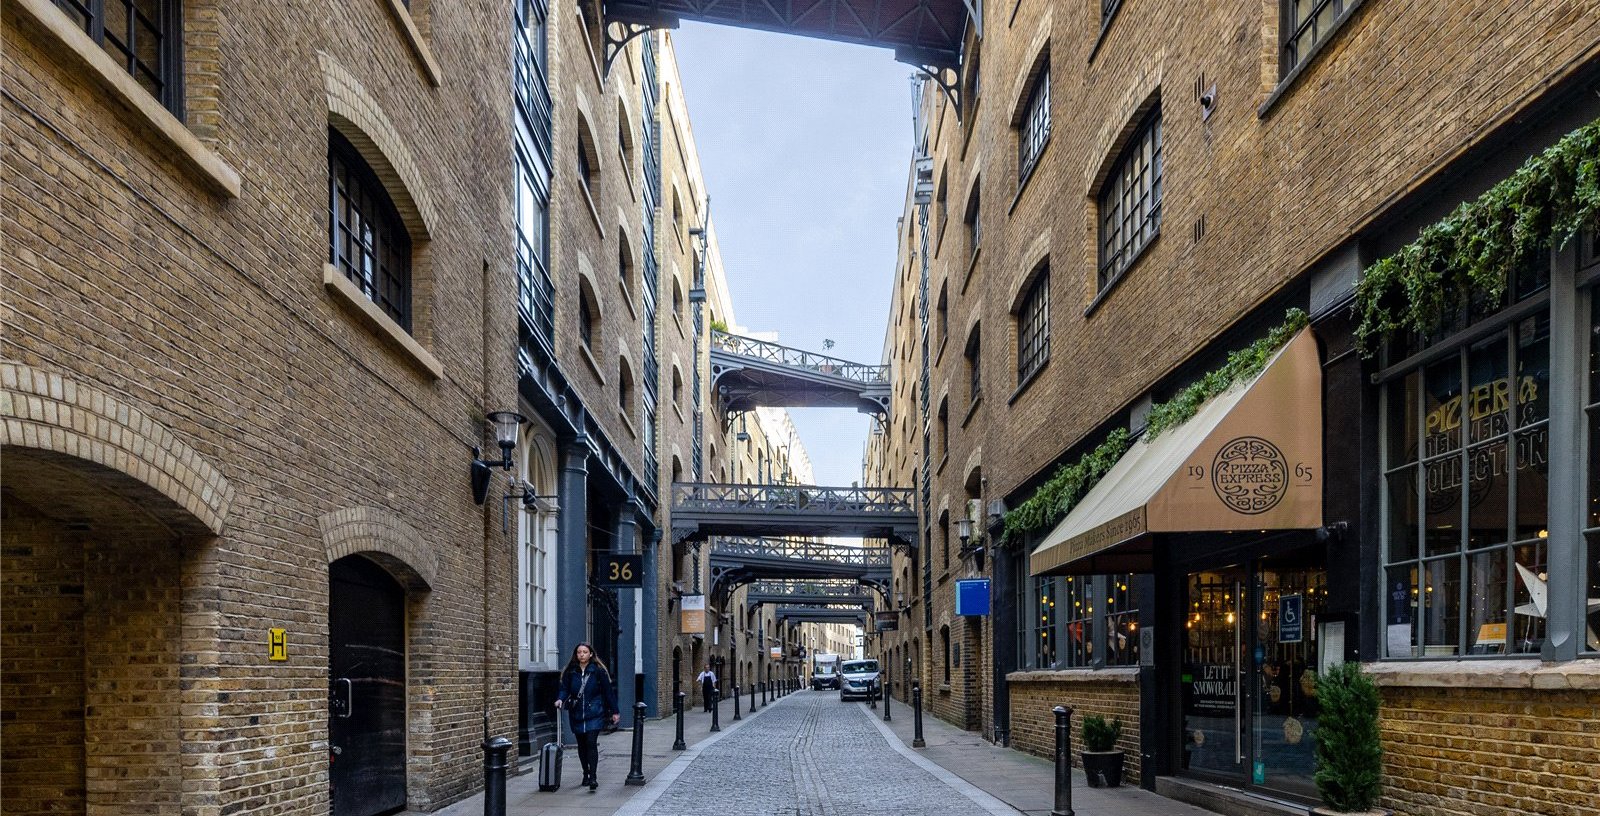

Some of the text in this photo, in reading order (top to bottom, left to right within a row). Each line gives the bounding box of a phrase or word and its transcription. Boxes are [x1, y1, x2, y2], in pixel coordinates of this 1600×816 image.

[1425, 376, 1538, 438] PIZERA
[1521, 402, 1539, 435] &
[1188, 464, 1205, 481] 19
[1230, 463, 1270, 474] PIZZA
[1295, 461, 1313, 482] 65
[1416, 431, 1548, 495] OLLCTION
[1220, 473, 1281, 484] EXPRESS
[1106, 523, 1124, 539] Since
[1125, 514, 1141, 535] 1965
[609, 561, 633, 581] 36
[271, 631, 284, 657] H
[1203, 665, 1231, 680] LET IT
